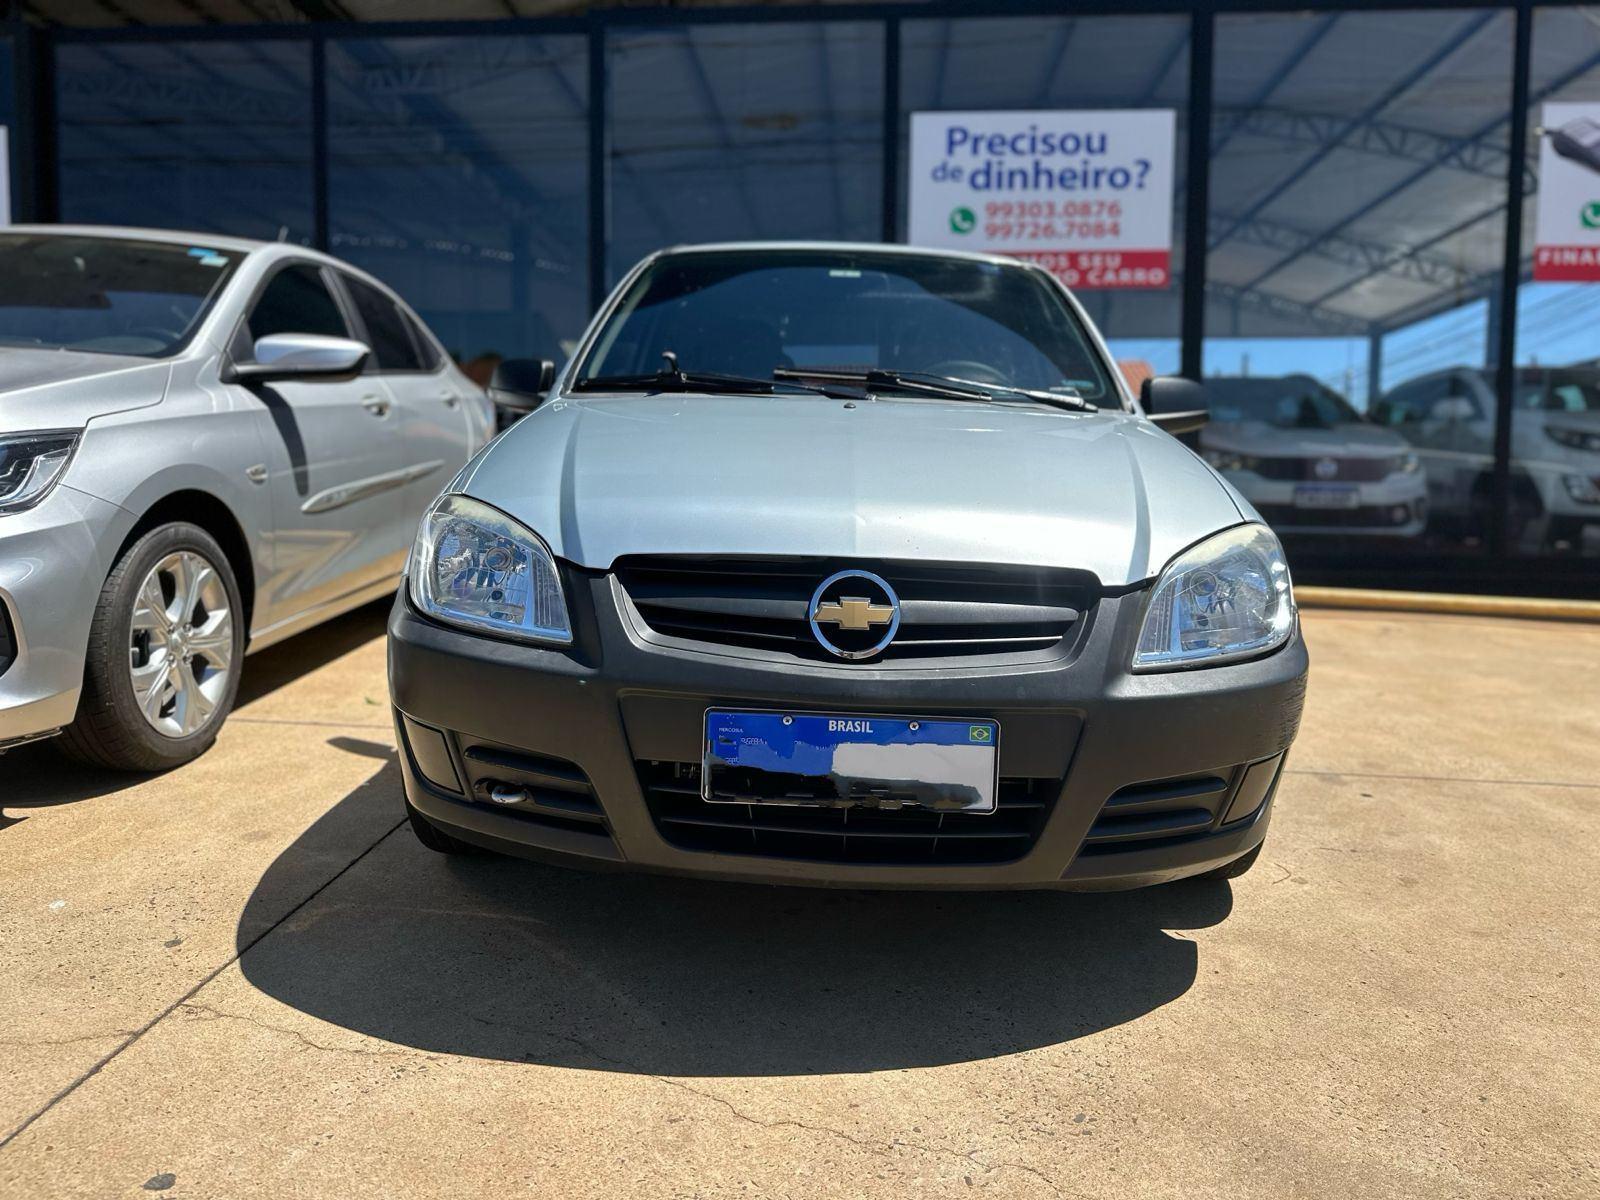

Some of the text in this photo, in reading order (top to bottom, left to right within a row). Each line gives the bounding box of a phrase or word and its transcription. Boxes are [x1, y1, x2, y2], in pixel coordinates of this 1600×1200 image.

[946, 125, 1108, 156] Precisou
[931, 158, 1152, 191] de dinheiro?
[985, 201, 1122, 219] 99303.0876
[985, 222, 1121, 239] 99726.7084
[1077, 252, 1121, 269] SEU
[1538, 249, 1600, 266] FINA
[1086, 267, 1166, 286] CARRO
[828, 720, 874, 734] BRASIL
